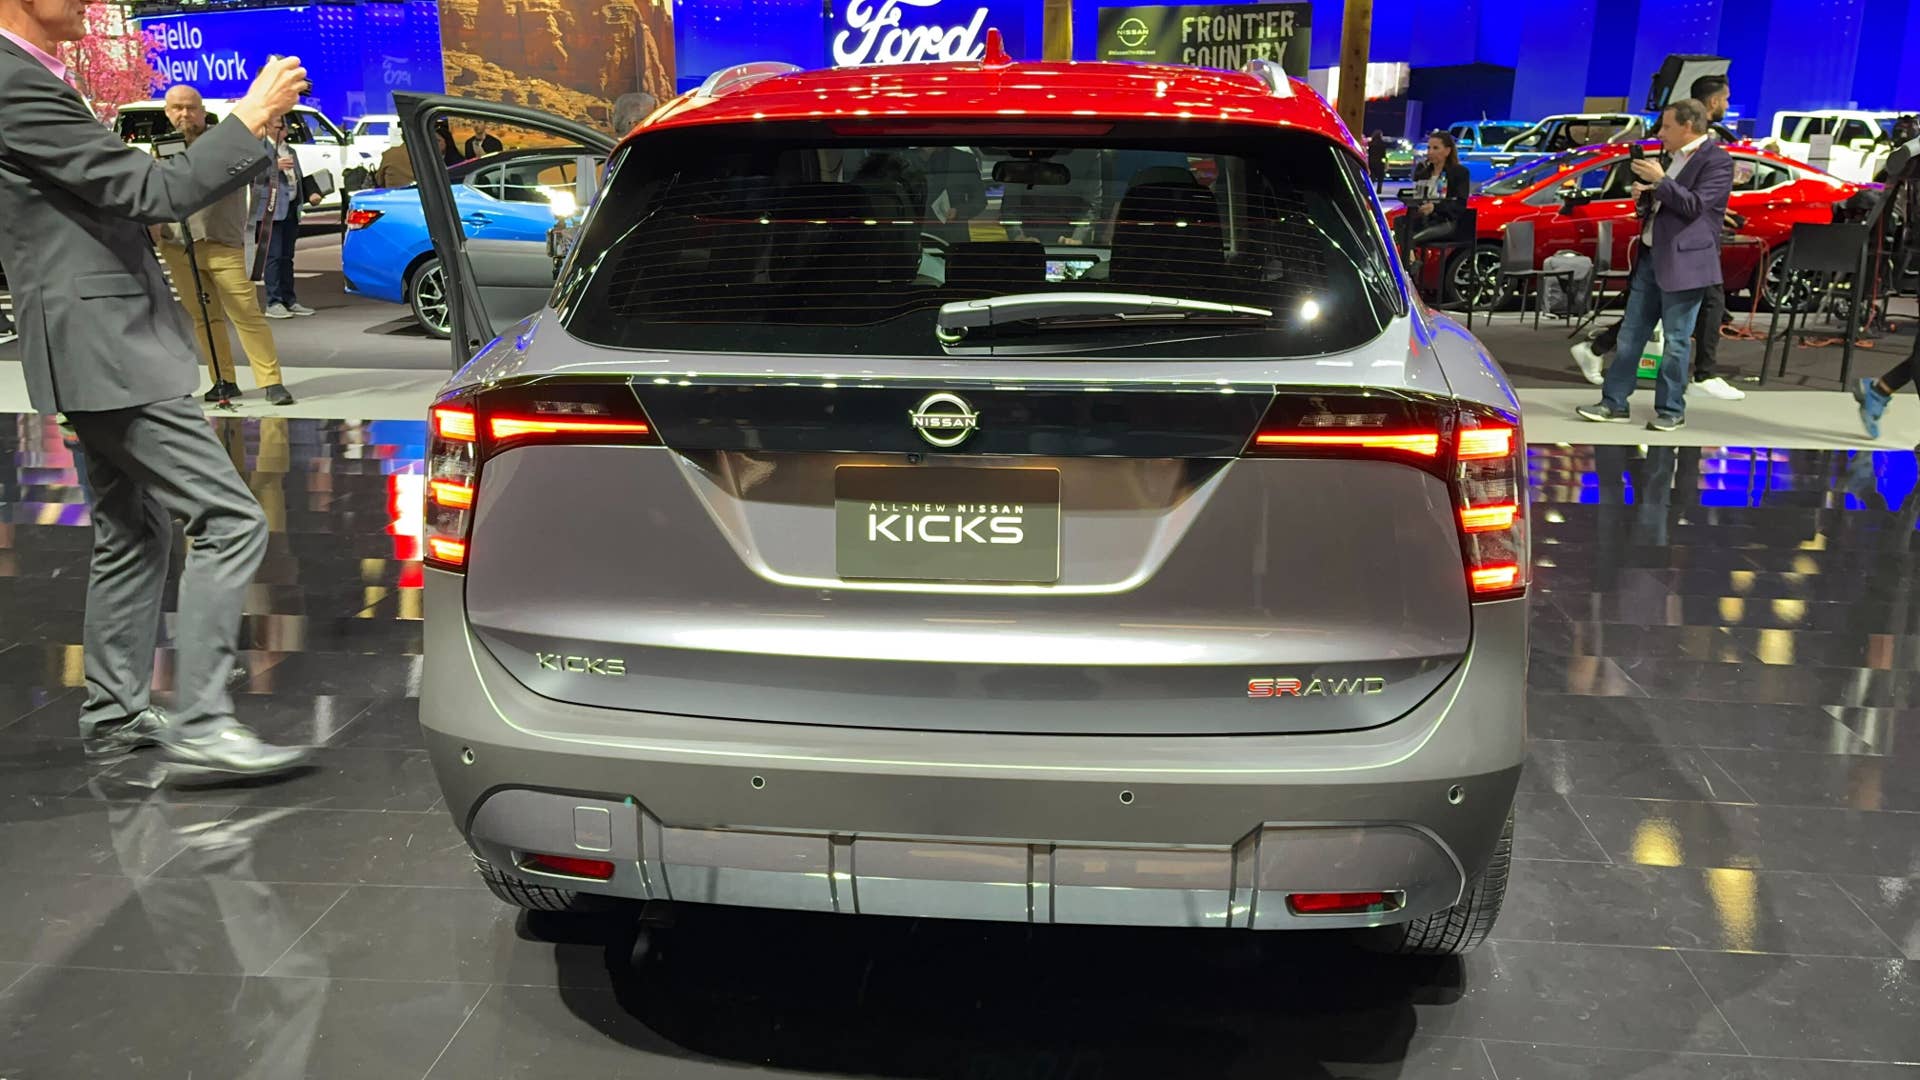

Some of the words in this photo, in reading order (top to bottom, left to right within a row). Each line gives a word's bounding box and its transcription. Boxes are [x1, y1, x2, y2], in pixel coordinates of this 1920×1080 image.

[833, 0, 989, 66] Ford
[1182, 10, 1295, 43] FRONTIER
[157, 55, 198, 81] New
[201, 51, 249, 81] York
[1183, 41, 1287, 71] COUNTRY
[912, 417, 976, 428] NISSAN
[869, 502, 946, 513] ALL-NEW
[957, 503, 1024, 514] NISSAN
[868, 514, 1024, 544] KICKS
[536, 652, 626, 676] KICKS
